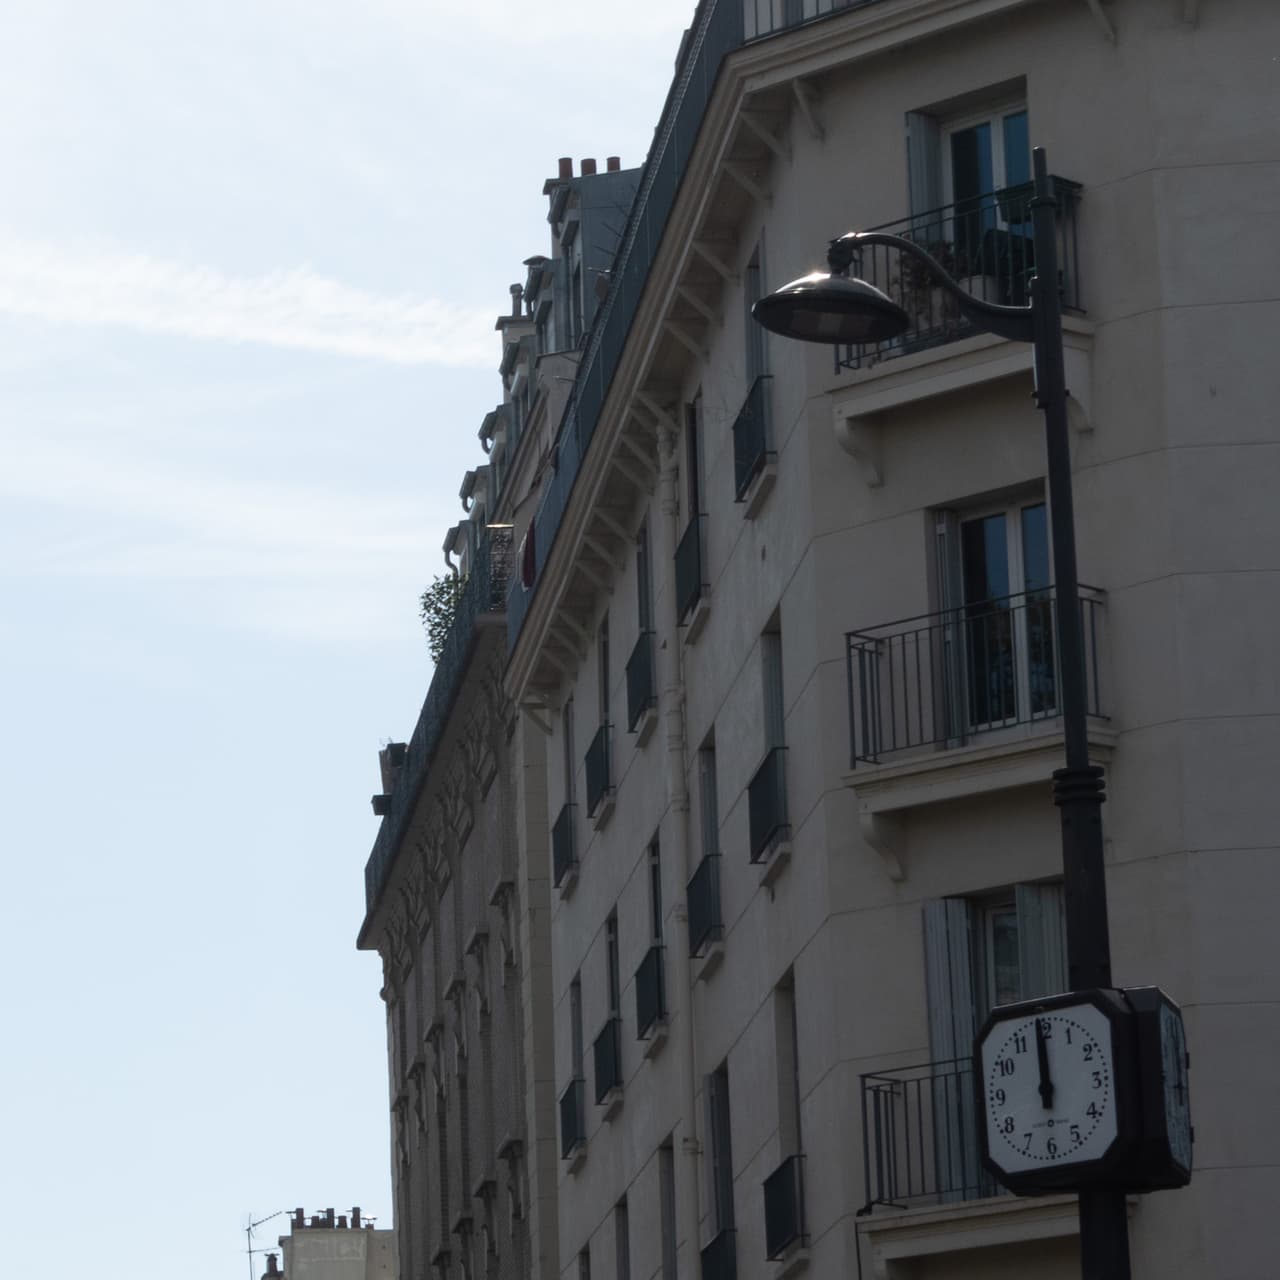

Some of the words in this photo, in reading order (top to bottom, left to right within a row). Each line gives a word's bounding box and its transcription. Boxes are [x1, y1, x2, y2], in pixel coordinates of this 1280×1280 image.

[1014, 1036, 1028, 1054] 11
[1065, 1027, 1073, 1045] 1
[1083, 1043, 1093, 1062] 2
[999, 1058, 1015, 1077] 10
[1092, 1071, 1102, 1089] 3
[995, 1089, 1006, 1106] 9
[1086, 1102, 1098, 1119] 4
[1004, 1116, 1015, 1134] 8
[1070, 1125, 1081, 1143] 5
[1023, 1133, 1033, 1150] 7
[1047, 1137, 1057, 1154] 6
